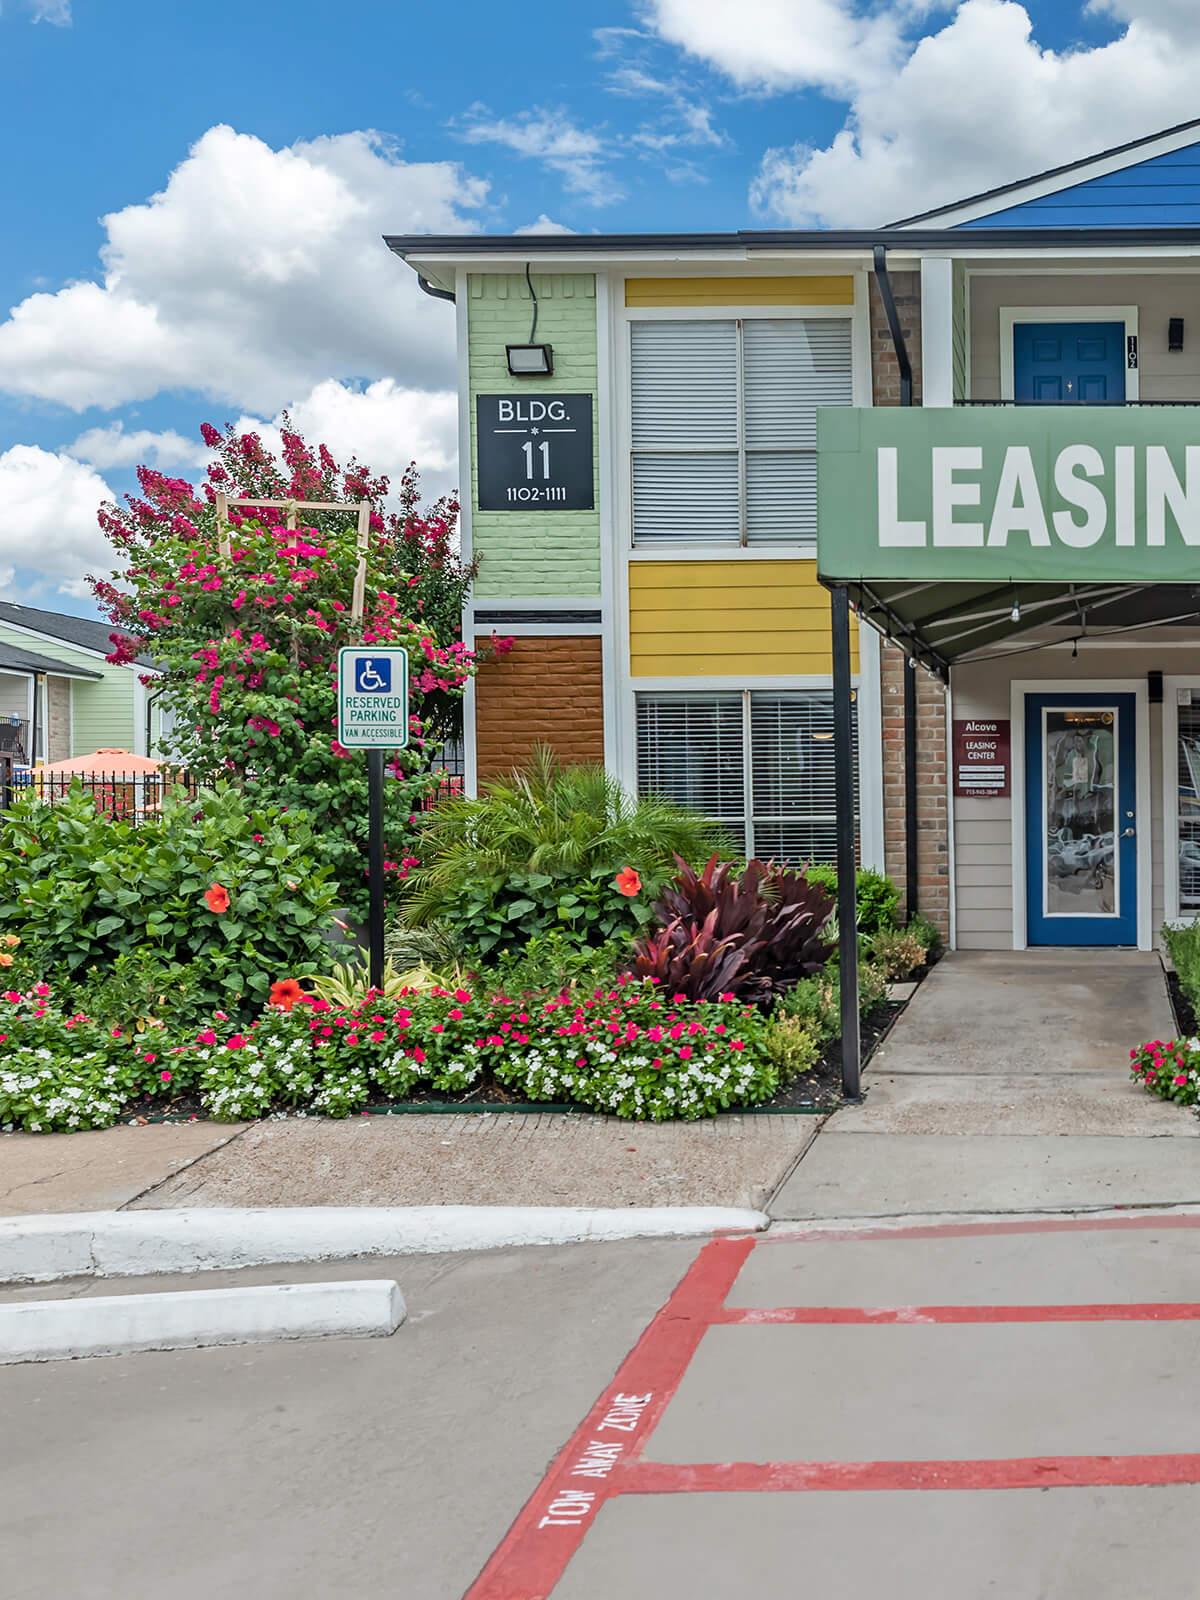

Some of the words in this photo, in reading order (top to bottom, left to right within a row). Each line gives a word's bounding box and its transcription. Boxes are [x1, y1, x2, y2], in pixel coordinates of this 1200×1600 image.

[1128, 336, 1137, 368] 1102
[499, 400, 570, 421] BLDG.
[521, 441, 550, 480] 11
[506, 487, 566, 501] 1102-1111
[345, 696, 401, 709] RESERVED
[350, 710, 397, 722] PARKING
[965, 721, 998, 731] Alcove
[344, 728, 359, 738] VAN
[361, 728, 403, 738] ACCESSIBLE
[966, 741, 997, 750] LEASING
[967, 751, 996, 760] CENTER
[538, 1490, 596, 1529] TOW
[570, 1440, 624, 1478] AWAY
[597, 1392, 653, 1431] ZONE
